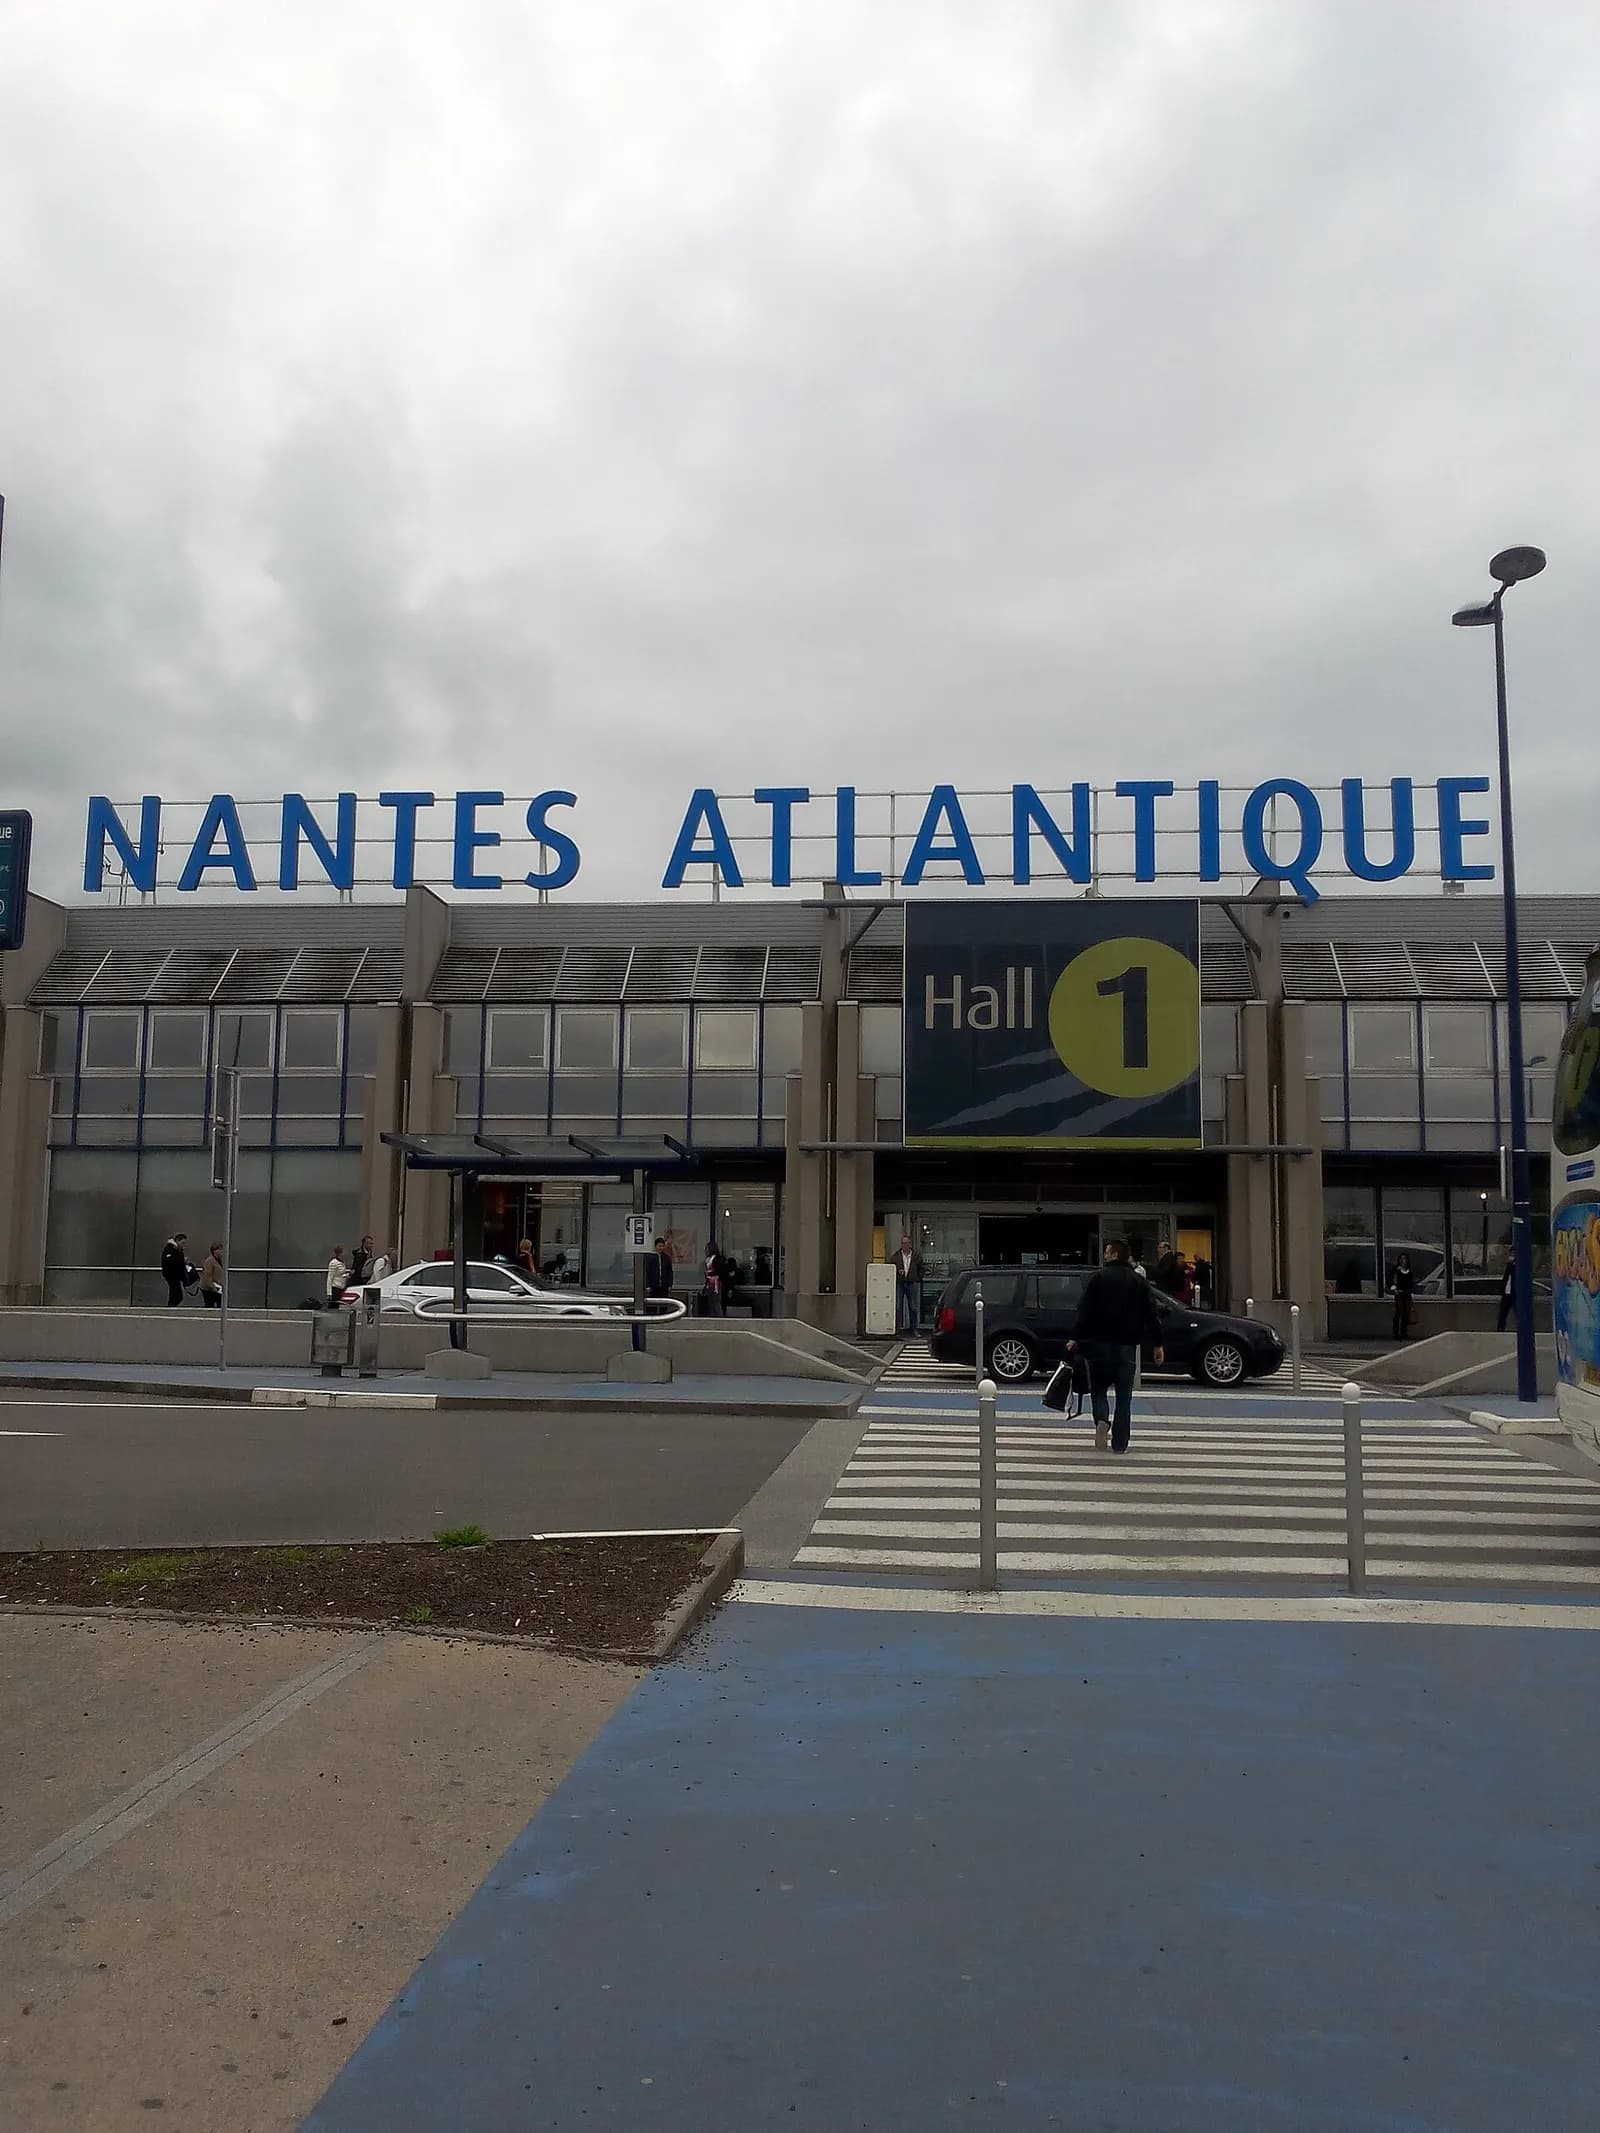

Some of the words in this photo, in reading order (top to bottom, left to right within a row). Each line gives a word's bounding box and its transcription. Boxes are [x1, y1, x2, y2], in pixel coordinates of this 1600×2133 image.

[84, 791, 580, 892] NANTES
[662, 777, 1495, 904] ATLANTIQUE
[925, 967, 1033, 1030] Hall
[1096, 966, 1148, 1069] 1
